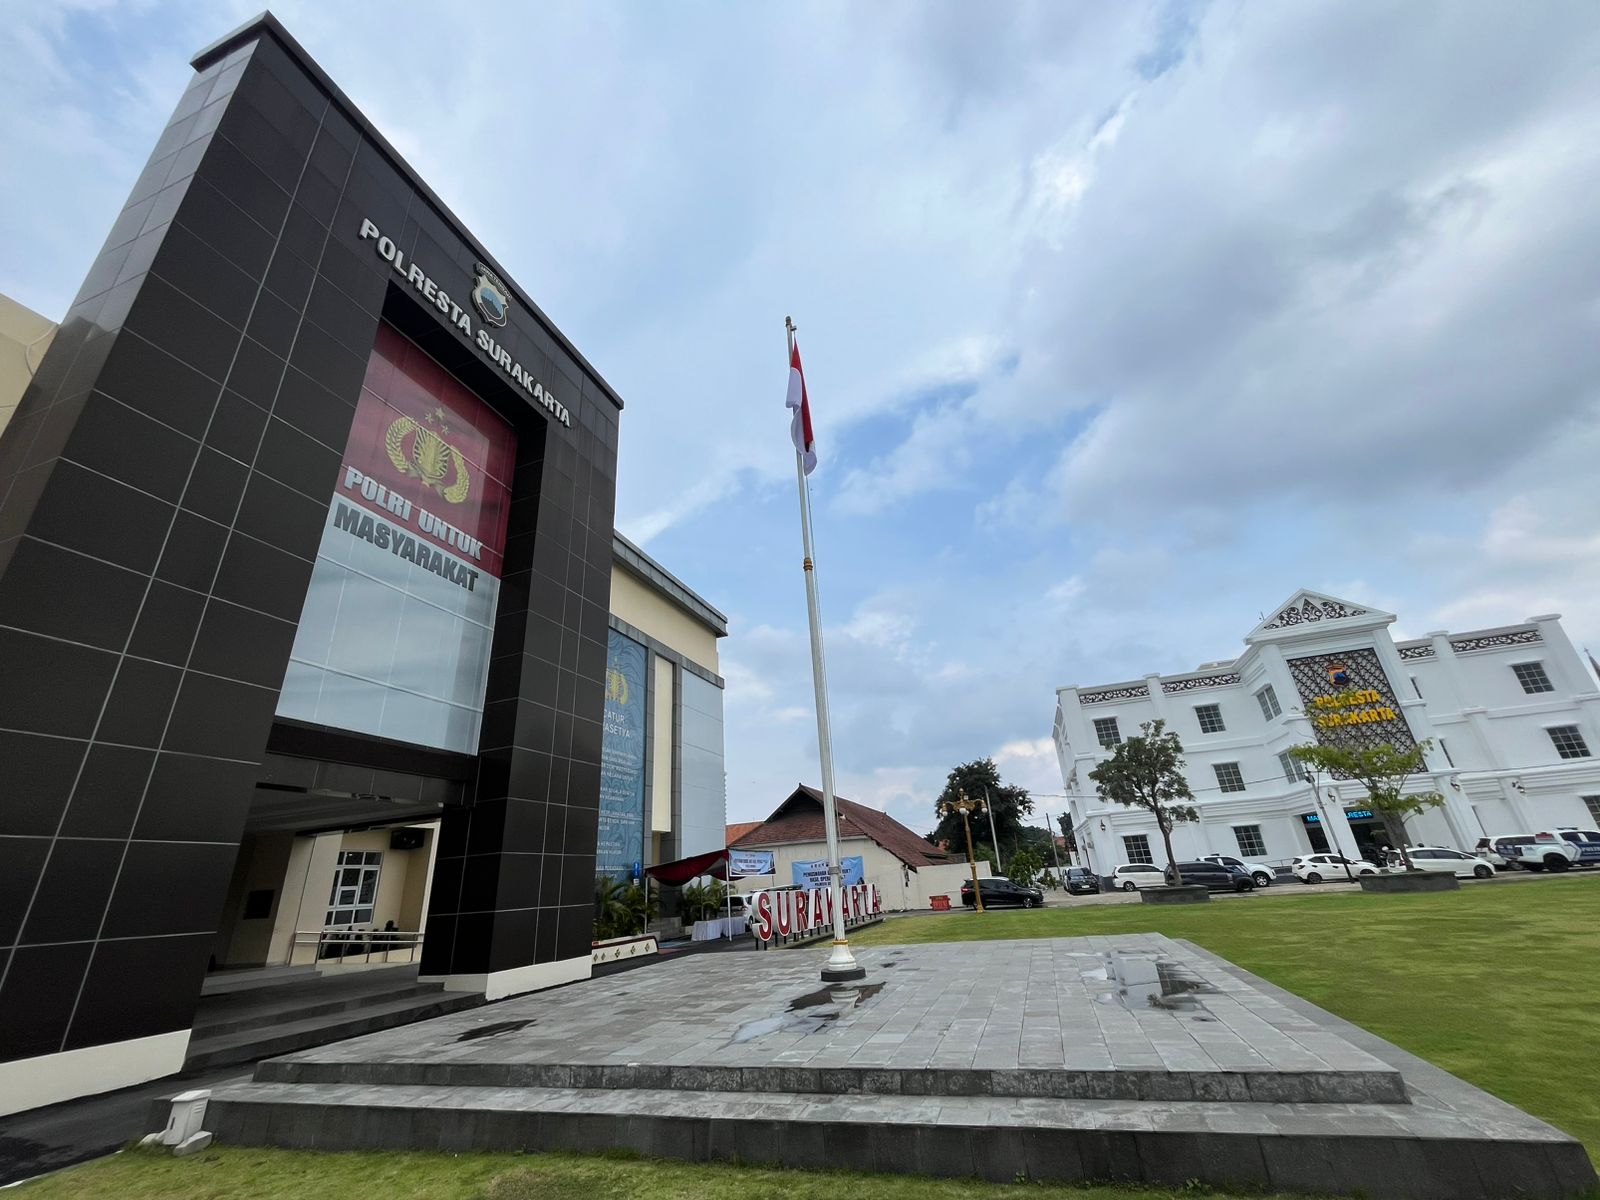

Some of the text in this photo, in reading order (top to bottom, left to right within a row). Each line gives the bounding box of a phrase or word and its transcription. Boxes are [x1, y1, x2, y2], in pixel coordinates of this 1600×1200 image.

[359, 218, 571, 427] POLRESTA SURAKARTA
[344, 466, 483, 561] POLRI UNTUK
[334, 503, 478, 592] MASYARAKAT
[1314, 690, 1380, 708] POLESTA
[1317, 707, 1396, 728] SURKARTA
[603, 722, 631, 738] ASETYA
